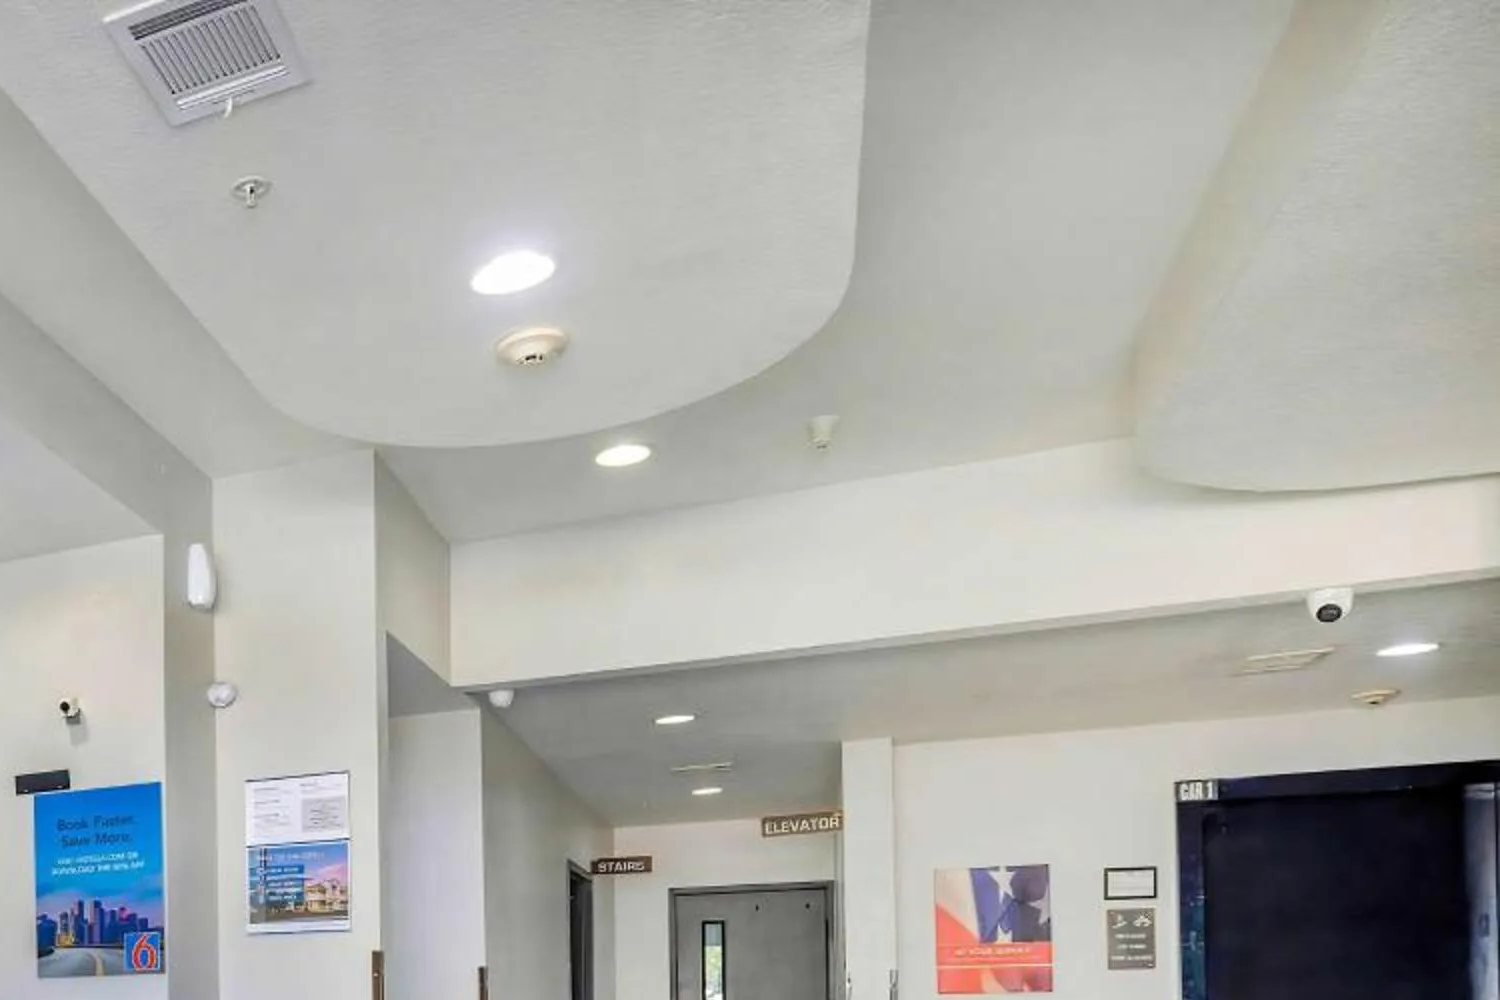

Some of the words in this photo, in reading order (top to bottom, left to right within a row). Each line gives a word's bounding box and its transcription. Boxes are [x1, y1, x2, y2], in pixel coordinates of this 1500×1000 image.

[57, 818, 89, 831] Book
[764, 817, 840, 835] ELEVATOR
[61, 835, 91, 848] Save
[597, 861, 645, 873] STAIRS
[131, 932, 156, 971] 6
